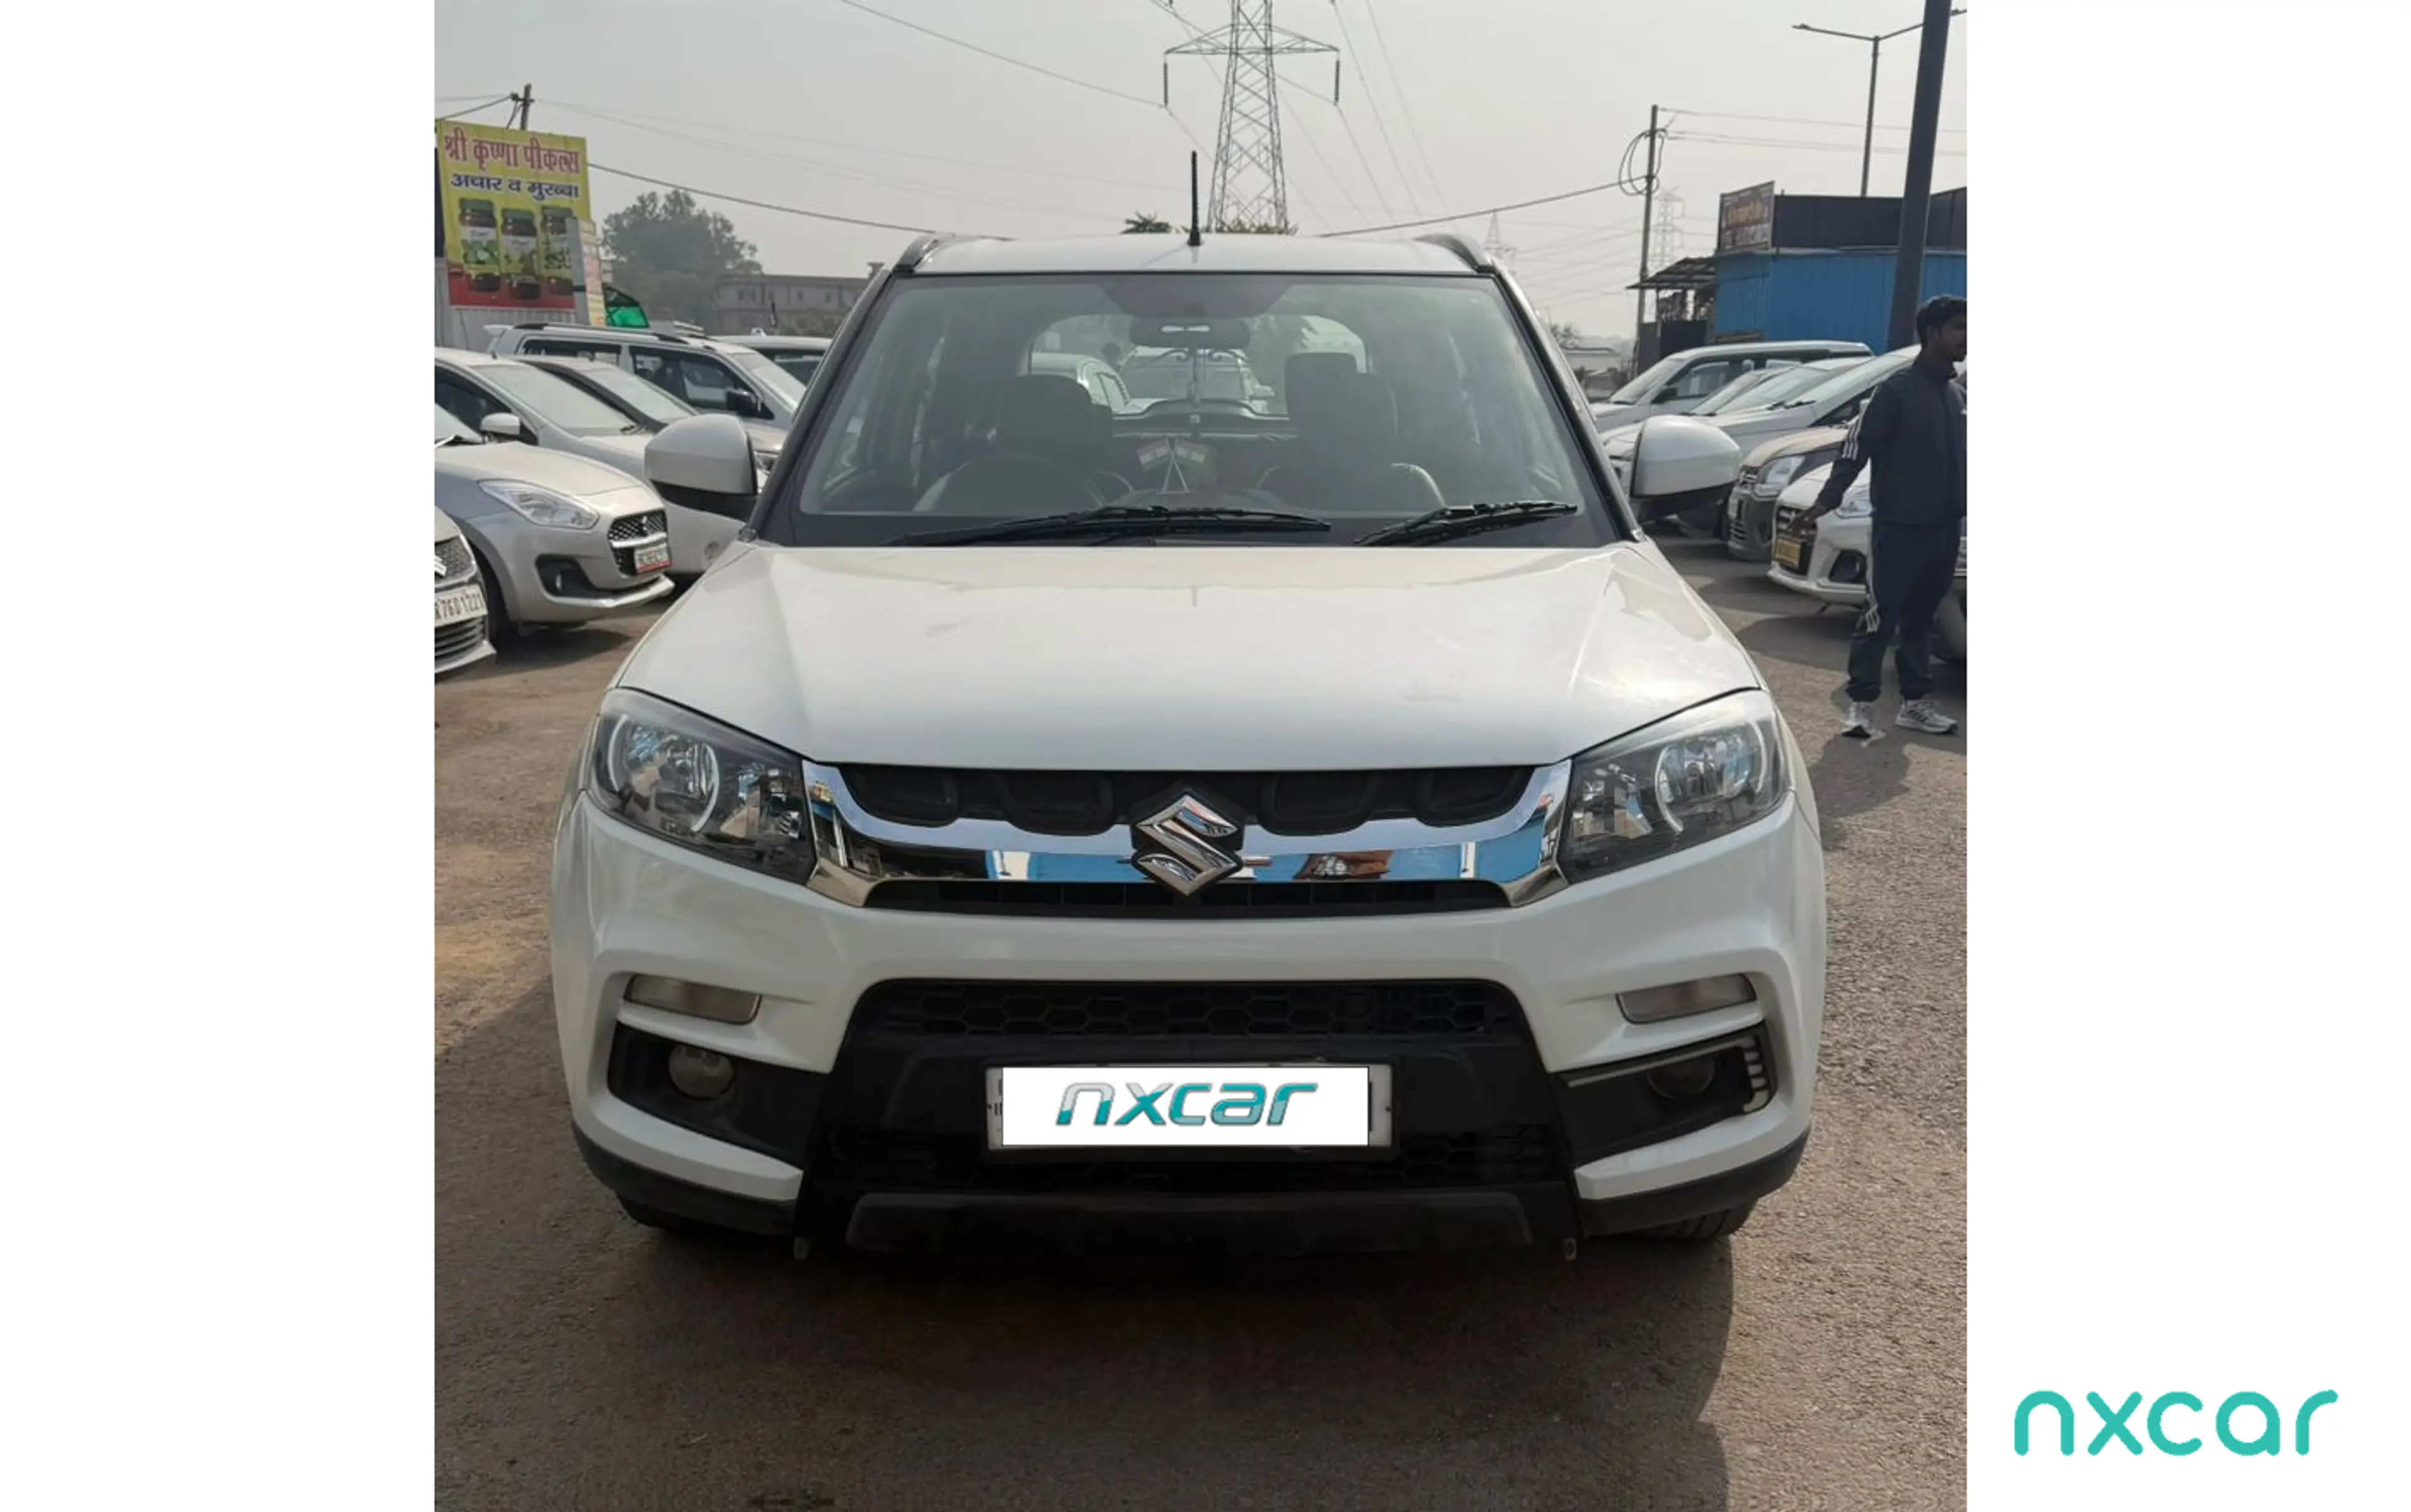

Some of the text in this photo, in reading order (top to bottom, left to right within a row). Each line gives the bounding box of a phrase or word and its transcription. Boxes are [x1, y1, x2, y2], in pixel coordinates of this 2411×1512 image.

[445, 127, 467, 161] श्री
[473, 139, 518, 170] कृष्णा
[451, 174, 502, 190] अचार
